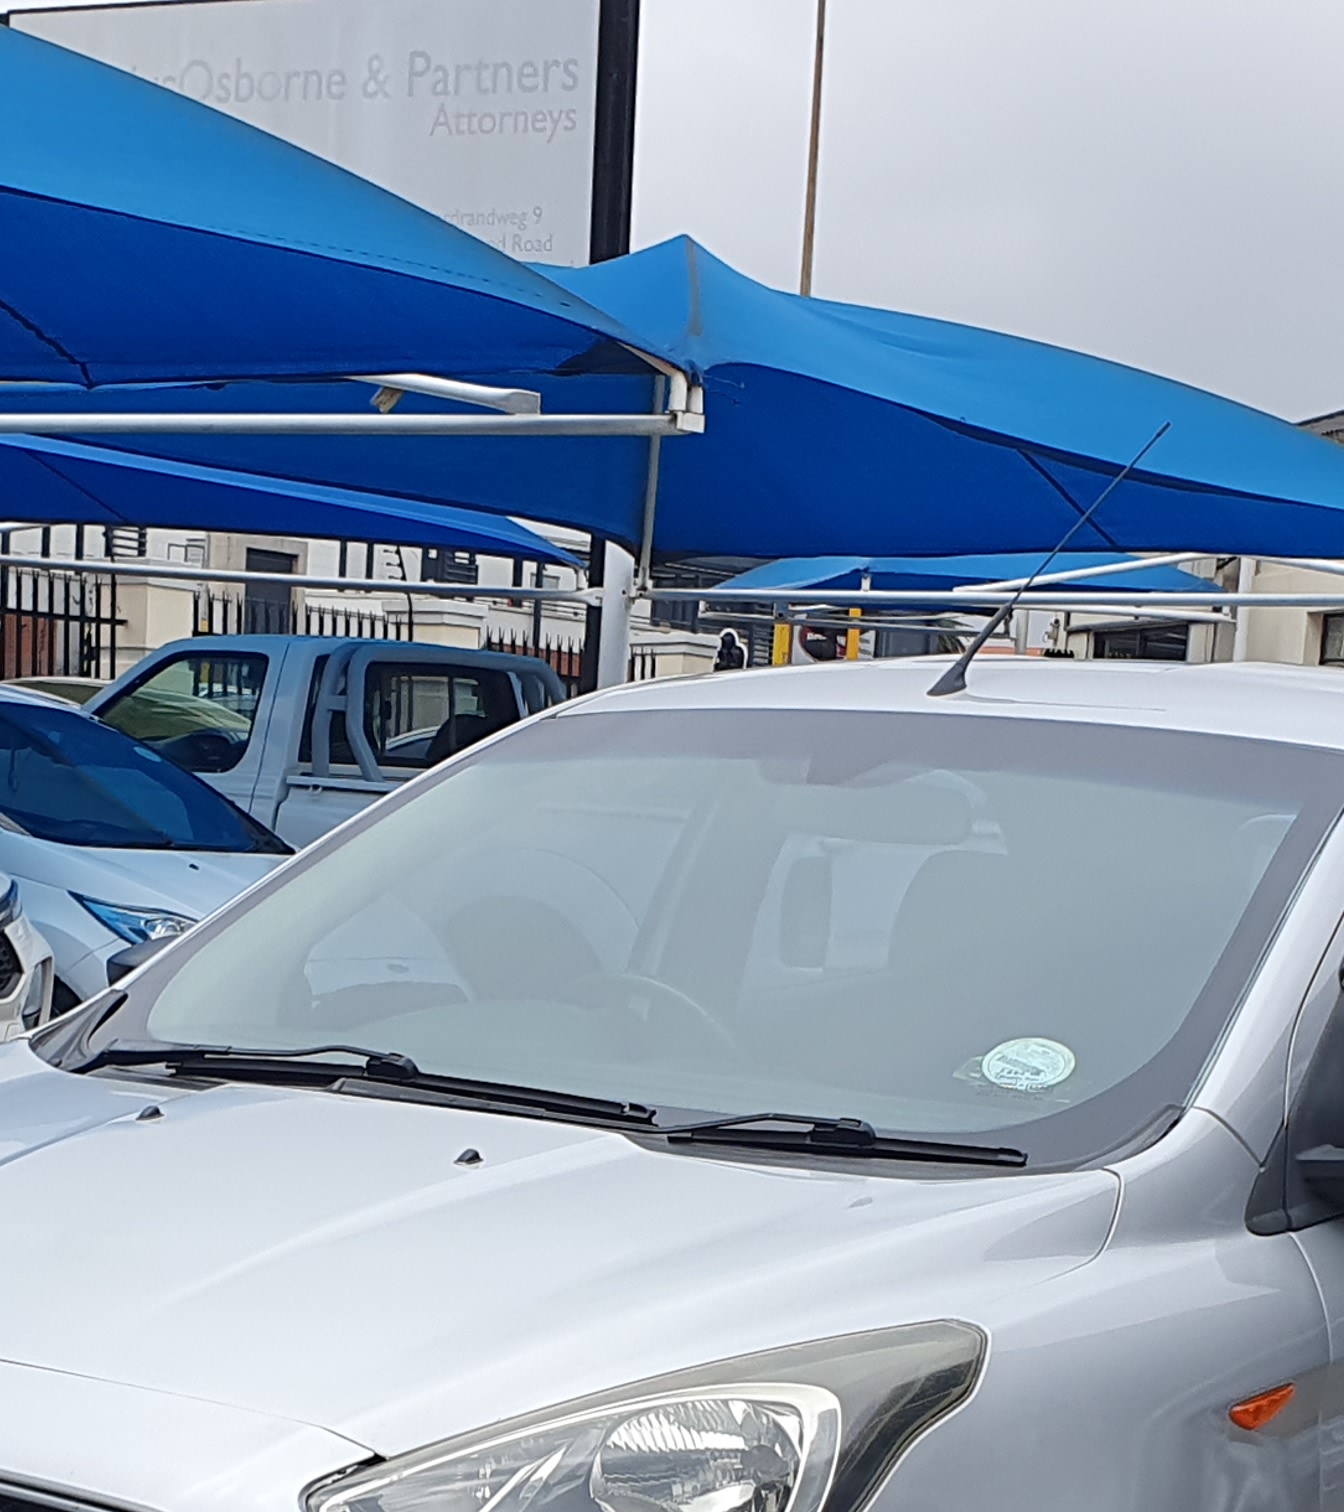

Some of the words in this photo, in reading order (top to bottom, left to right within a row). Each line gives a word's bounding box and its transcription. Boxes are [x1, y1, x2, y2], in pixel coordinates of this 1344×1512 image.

[130, 54, 346, 104] Osborne
[362, 52, 392, 99] &
[407, 50, 580, 98] Partners
[426, 102, 578, 144] Attorneys
[532, 205, 543, 225] 9
[512, 233, 553, 253] Road
